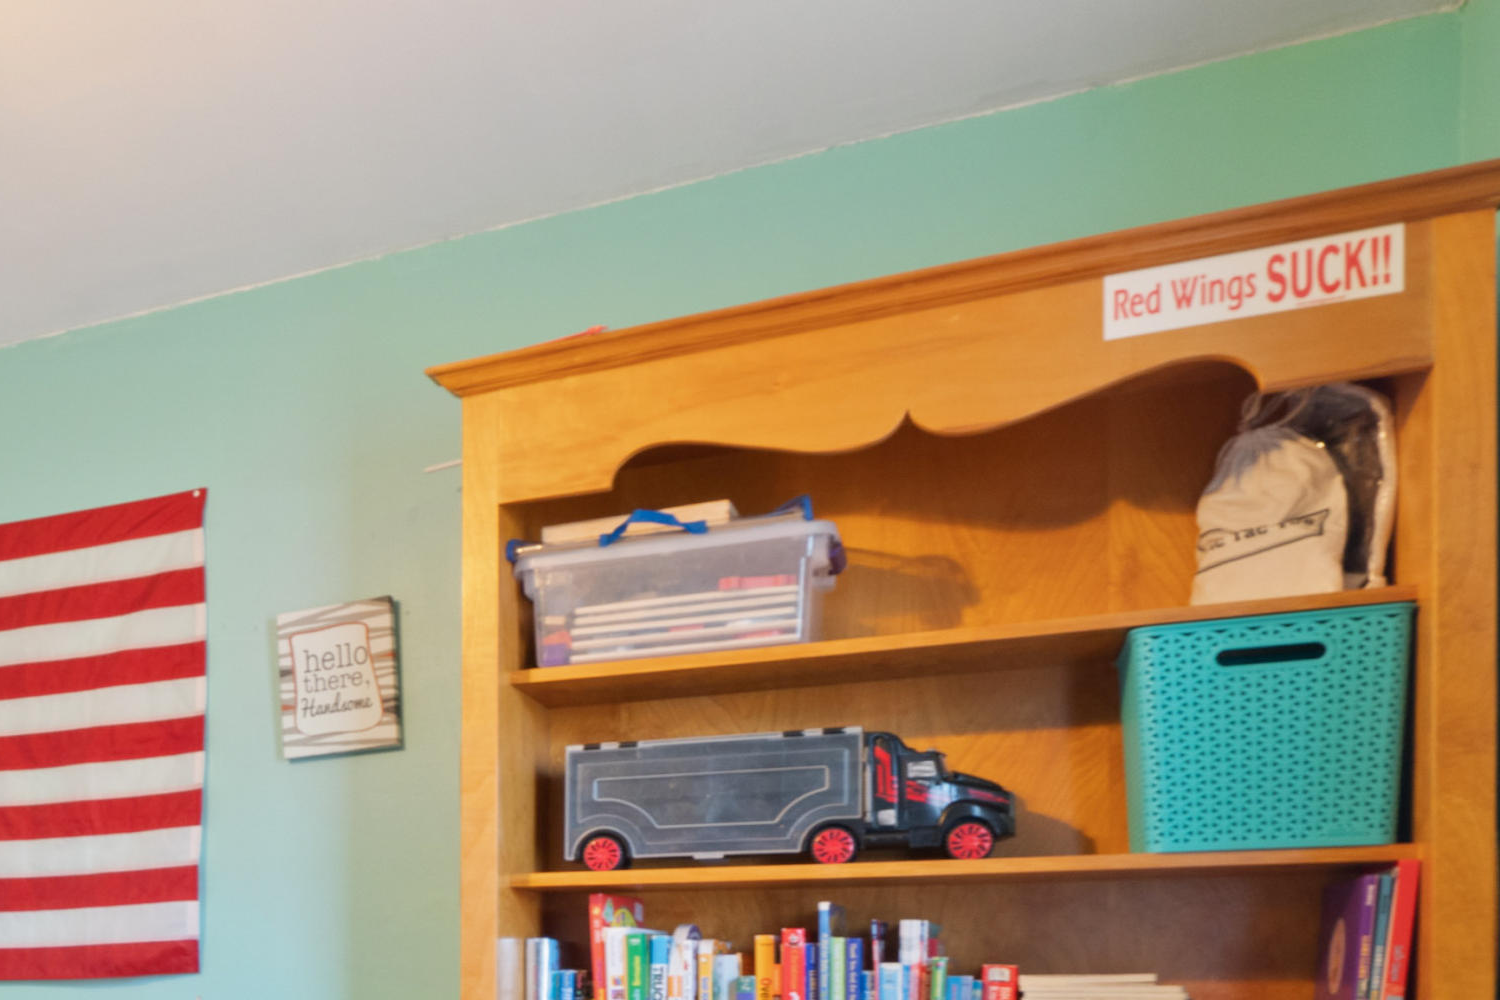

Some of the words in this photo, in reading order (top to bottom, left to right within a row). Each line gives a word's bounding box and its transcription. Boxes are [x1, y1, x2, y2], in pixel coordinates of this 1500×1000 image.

[1112, 283, 1162, 321] Red
[1170, 273, 1257, 311] Wings
[1265, 234, 1392, 303] SUCK!!
[303, 643, 369, 674] hello
[301, 692, 373, 718] Handsome
